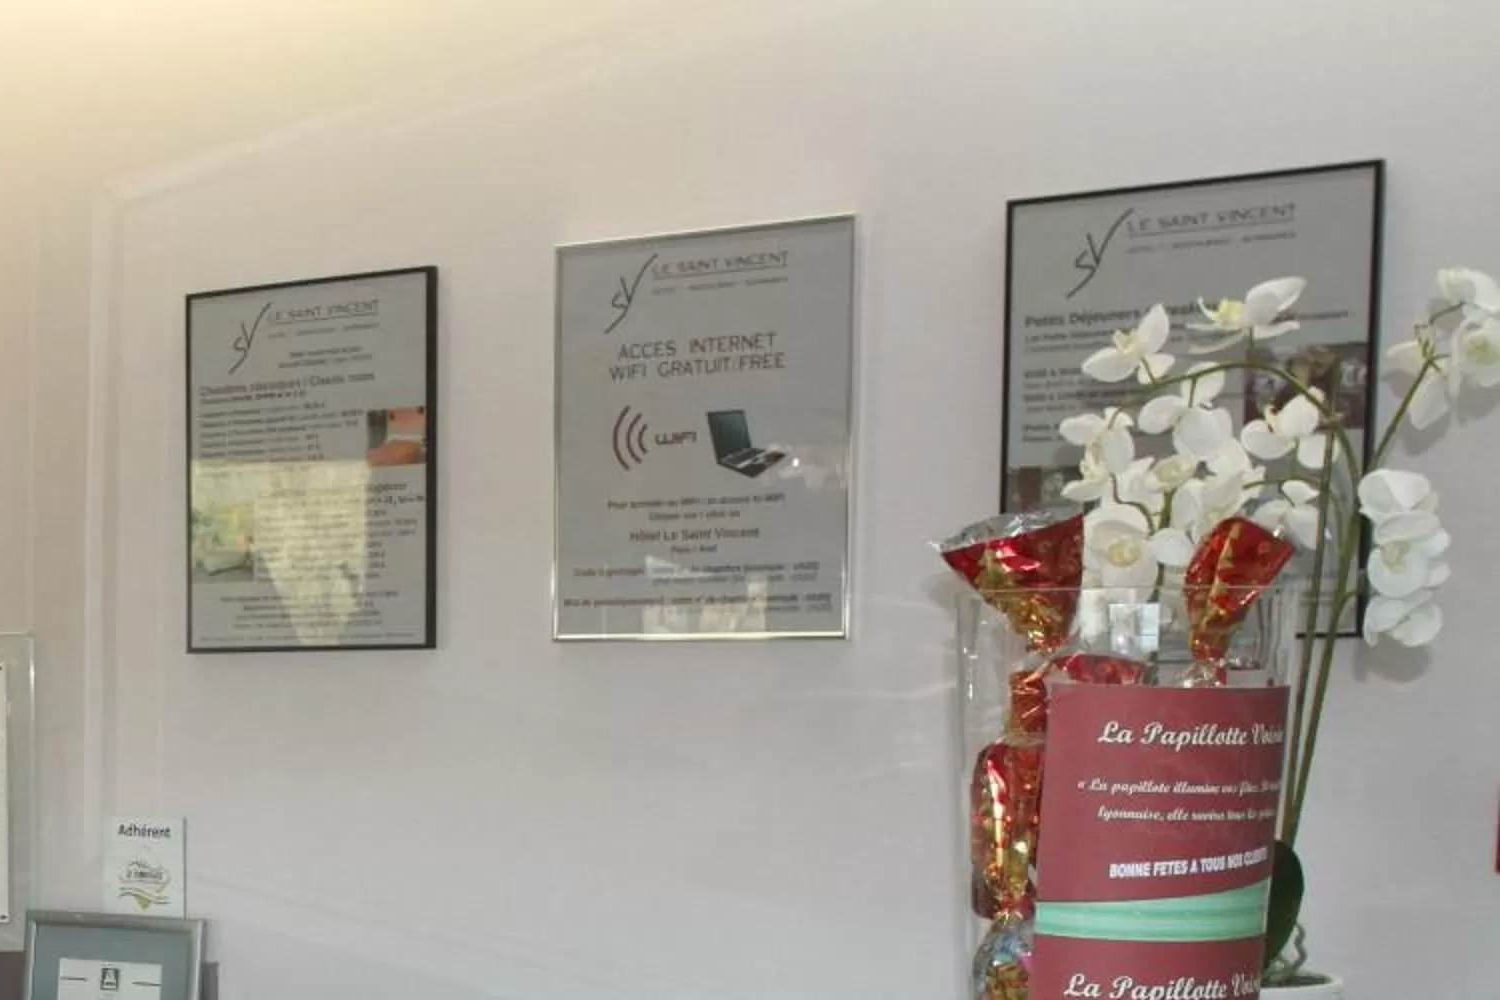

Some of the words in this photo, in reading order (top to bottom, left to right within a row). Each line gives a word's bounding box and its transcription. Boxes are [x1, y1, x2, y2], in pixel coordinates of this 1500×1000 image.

[1216, 203, 1296, 223] VINCENT
[676, 257, 719, 273] SAINT
[725, 251, 789, 268] VINCENT
[617, 340, 676, 361] ACCES
[689, 331, 778, 354] INTERNET
[609, 363, 647, 384] WIFI
[1097, 720, 1134, 744] La
[1140, 721, 1249, 752] Papillotte
[1108, 862, 1150, 879] BONNE
[1153, 859, 1188, 877] FETES
[1189, 858, 1199, 873] A
[1200, 855, 1225, 873] TOUS
[1063, 973, 1102, 998] La
